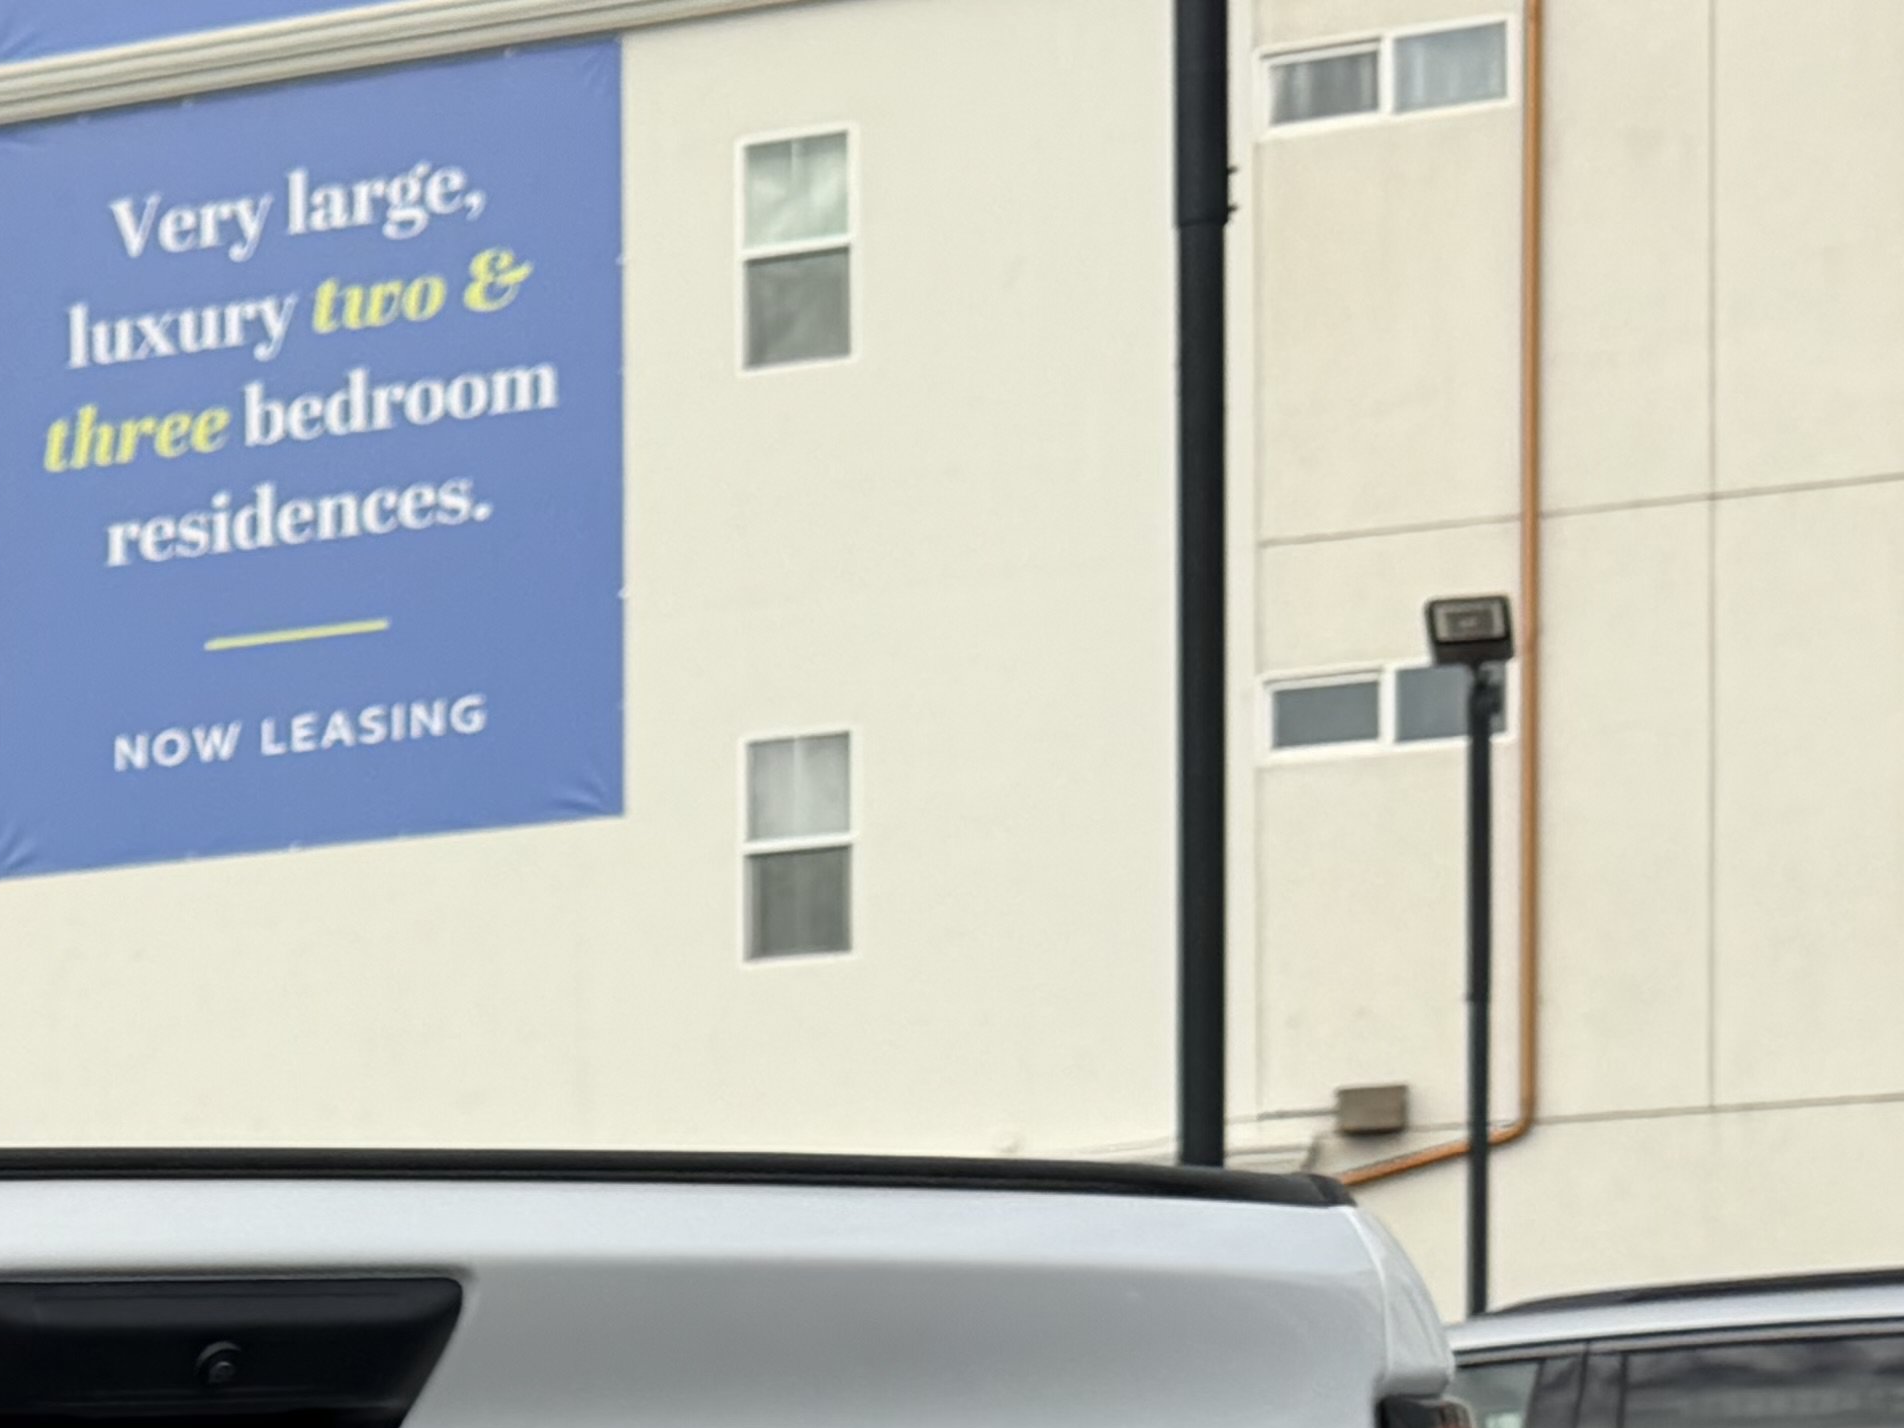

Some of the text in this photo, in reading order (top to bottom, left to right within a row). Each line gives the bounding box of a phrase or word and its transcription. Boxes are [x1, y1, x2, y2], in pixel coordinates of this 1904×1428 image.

[110, 162, 487, 262] Very large,
[66, 247, 533, 369] luxury two &
[43, 362, 558, 474] three bedroom
[105, 478, 493, 567] residences.
[113, 694, 489, 772] NOW LEASING
